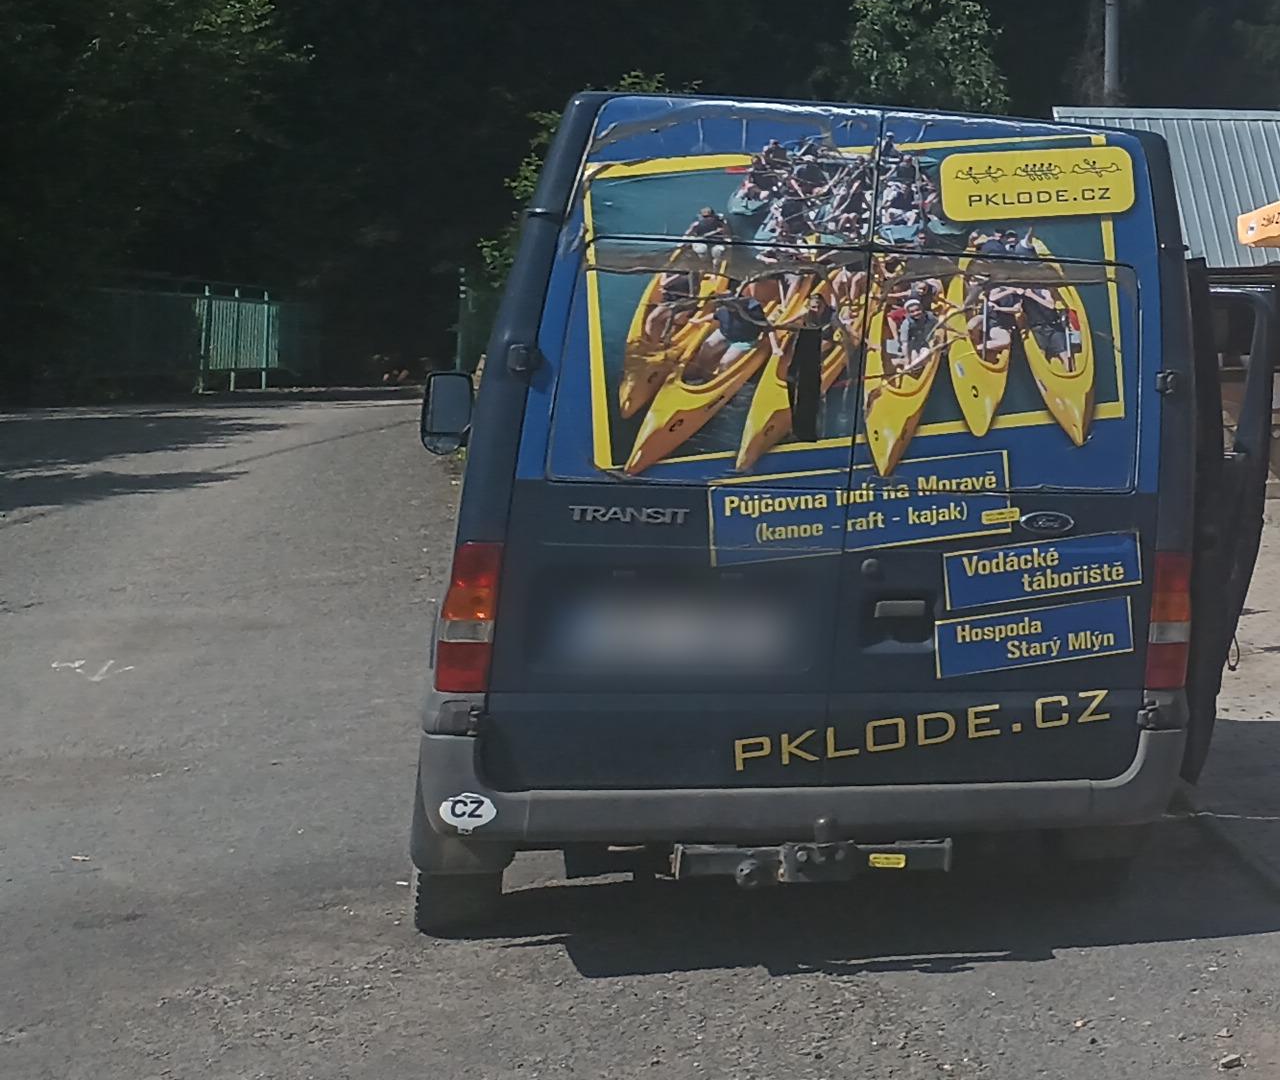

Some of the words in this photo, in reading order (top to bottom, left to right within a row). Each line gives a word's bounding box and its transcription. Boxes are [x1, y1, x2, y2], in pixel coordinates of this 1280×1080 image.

[968, 187, 1112, 207] PKLODE.CZ
[724, 493, 828, 518] Půjčovna
[917, 471, 998, 496] Moravě
[568, 505, 690, 524] TRANSIT
[755, 520, 824, 545] (kanoe
[846, 511, 886, 532] raft
[908, 502, 969, 526] kajak)
[962, 547, 1060, 577] Vodácké
[1021, 560, 1125, 593] tábořiště
[956, 617, 1043, 643] Hospoda
[1007, 636, 1061, 660] Starý
[1067, 630, 1115, 652] Mlýn
[734, 689, 1111, 771] PKLODE.CZ
[451, 799, 485, 818] CZ
